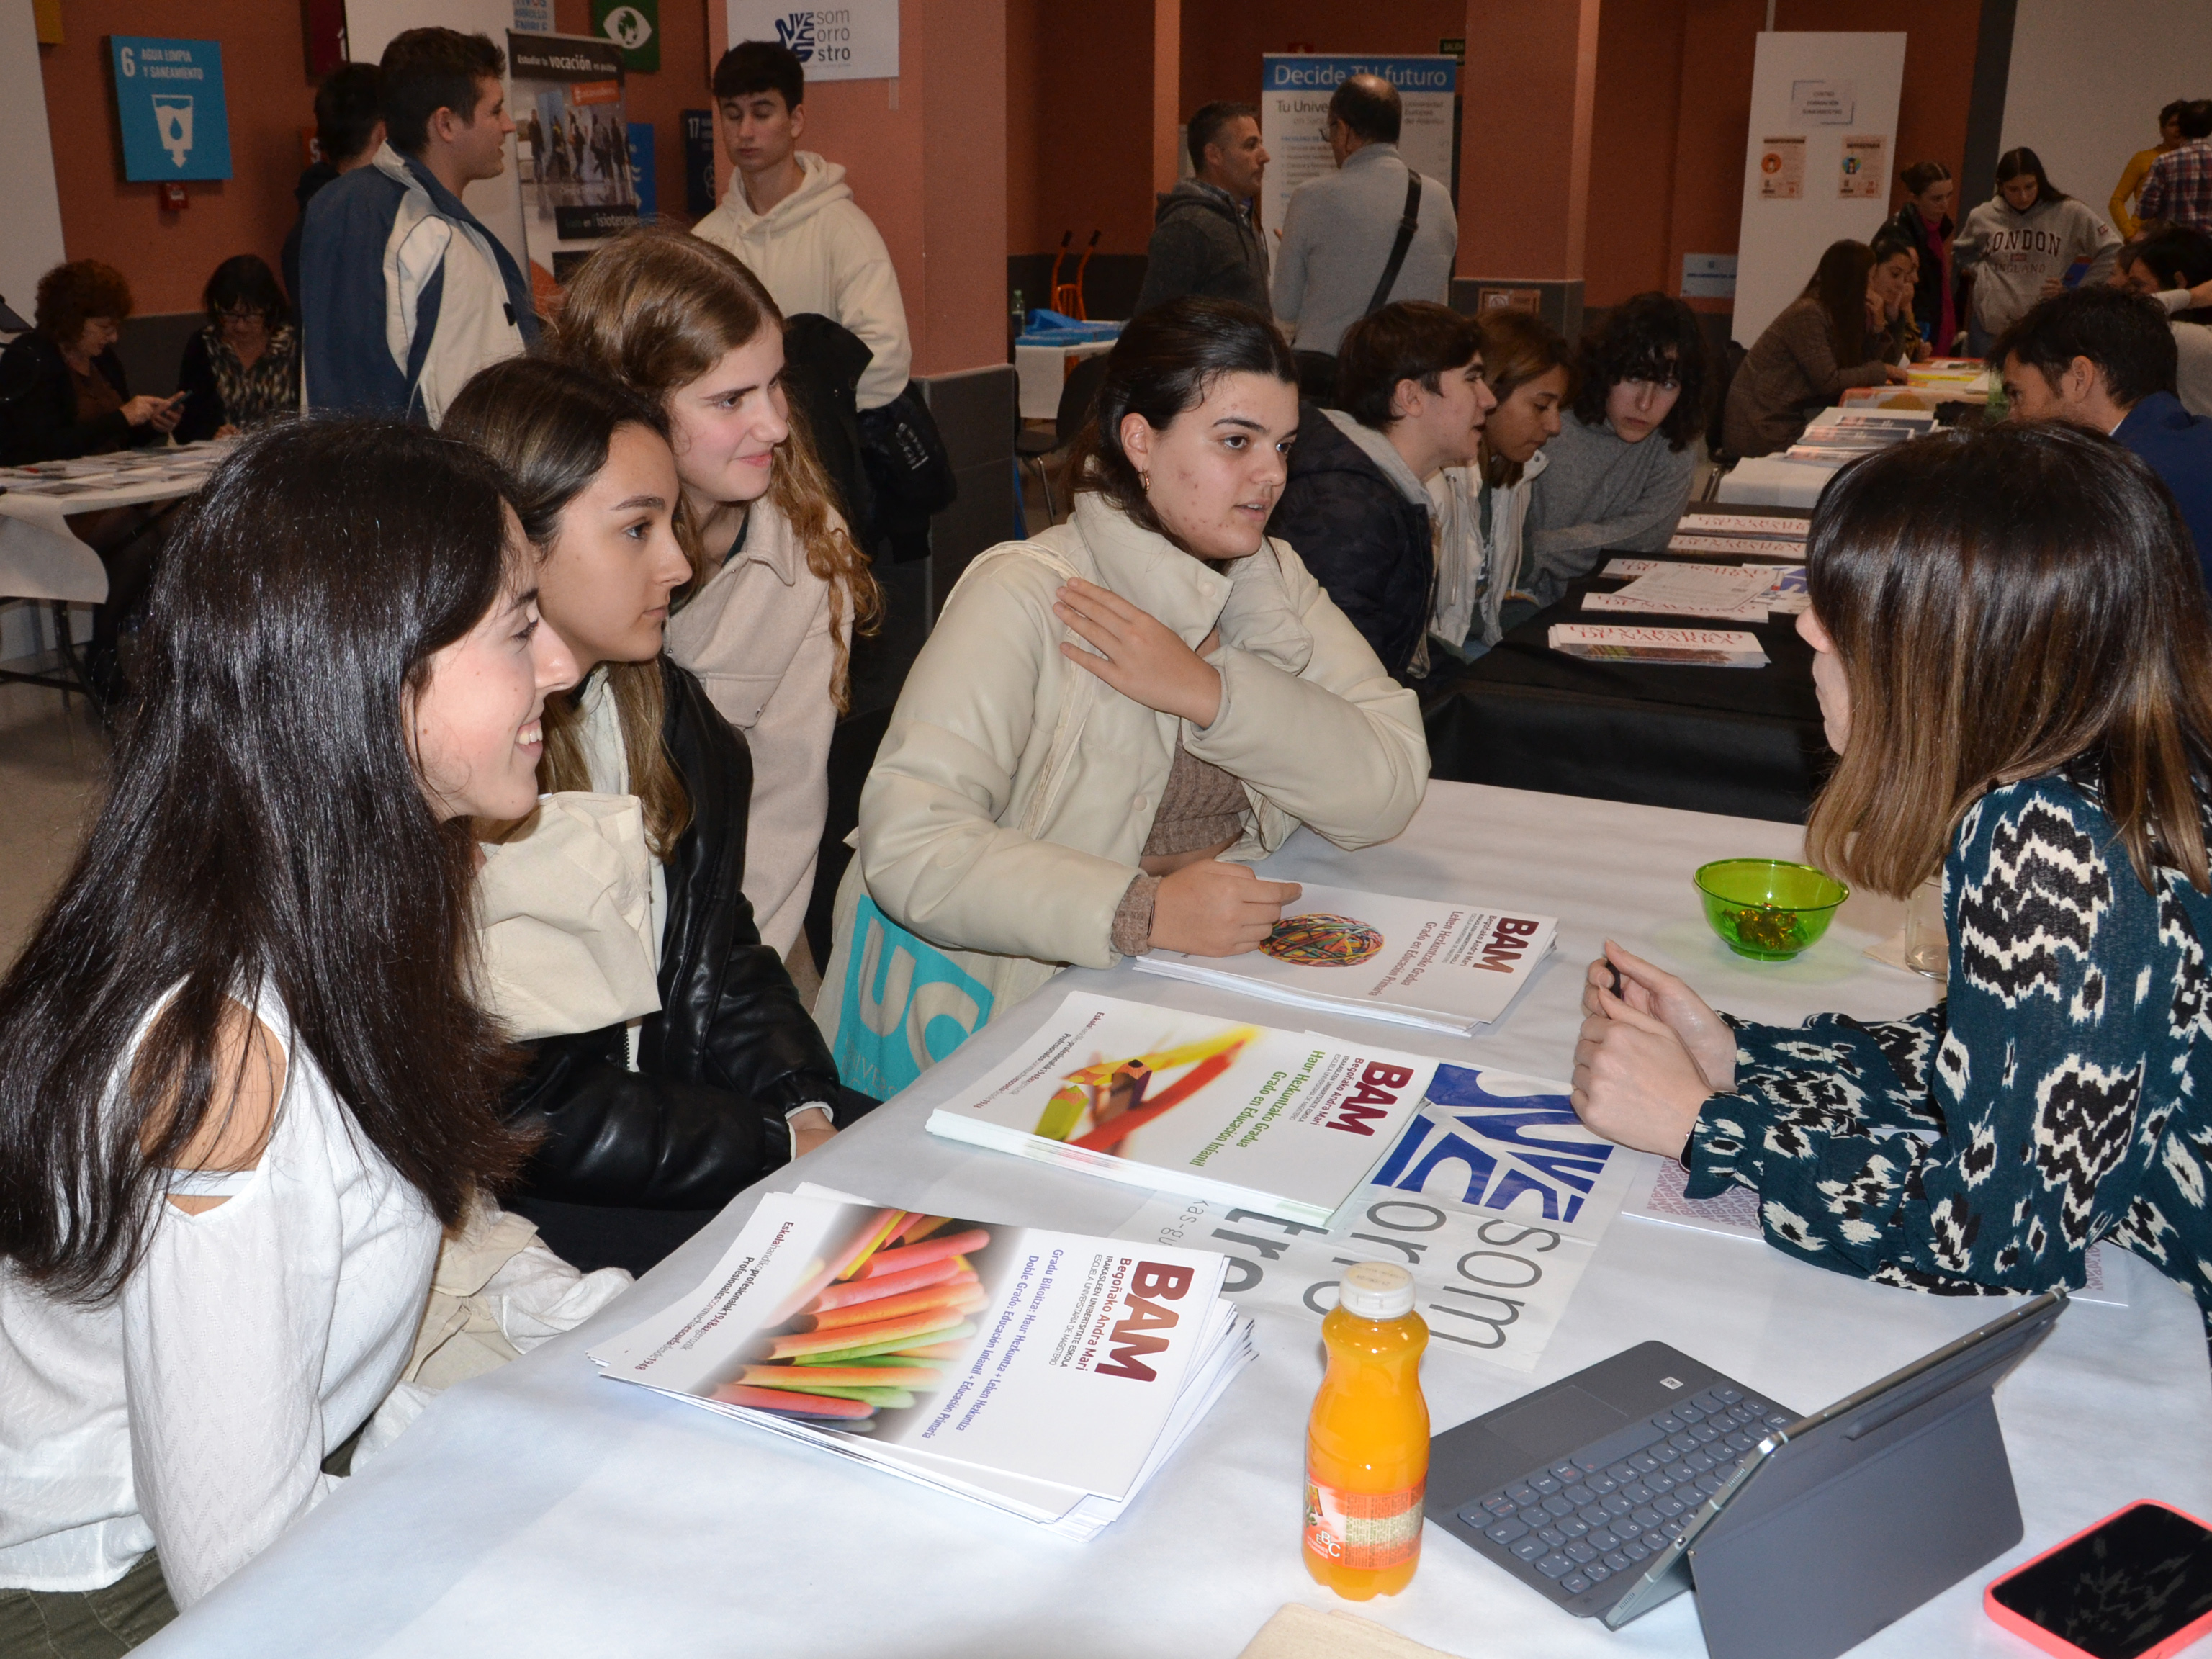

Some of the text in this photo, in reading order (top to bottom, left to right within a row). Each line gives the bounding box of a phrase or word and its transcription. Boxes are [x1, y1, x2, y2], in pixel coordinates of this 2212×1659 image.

[817, 9, 850, 24] som
[817, 28, 850, 42] orro
[121, 46, 135, 77] 6
[549, 55, 591, 71] vocación
[818, 45, 850, 62] stro
[1274, 65, 1346, 85] Decide
[1385, 65, 1447, 86] futuro
[1276, 99, 1290, 112] Tu
[688, 117, 699, 138] 17
[1416, 922, 1437, 940] Grado
[1401, 911, 1464, 986] Lehen Hezkuntzako Gradua
[1467, 940, 1483, 956] Andra
[1473, 917, 1539, 974] BAM
[1388, 950, 1419, 976] Educación
[1460, 955, 1472, 967] Mari
[1367, 976, 1396, 996] Primaria
[1236, 1050, 1326, 1148] Haur Hezkuntzako Gradua
[1310, 1057, 1365, 1126] Begoñako Andra Mari
[1325, 1061, 1415, 1136] BAM
[1189, 1071, 1287, 1167] Grado en Educación Infantil
[1021, 1255, 1039, 1280] Doble
[1045, 1249, 1064, 1275] Gradu
[1007, 1282, 1028, 1310] Grado:
[1028, 1277, 1053, 1313] Bikoitza:
[1428, 1219, 1562, 1350] som
[1049, 1254, 1102, 1366] ESCUELA UNIVERSITARIA DE MAGISTERIO
[1059, 1256, 1113, 1367] IRAKASLEEN UNIBERTSITATE ESKOLA
[1076, 1257, 1133, 1371] Begoñako Andra Mari
[1094, 1261, 1195, 1382] BAM
[986, 1310, 1015, 1349] Educación
[1019, 1314, 1036, 1334] Haur
[970, 1349, 994, 1375] Infantil
[997, 1334, 1026, 1372] Hezkuntza
[943, 1380, 974, 1412] Educación
[979, 1379, 1001, 1399] Lehen
[922, 1413, 950, 1439] Primaria
[956, 1399, 987, 1431] Hezkuntza
